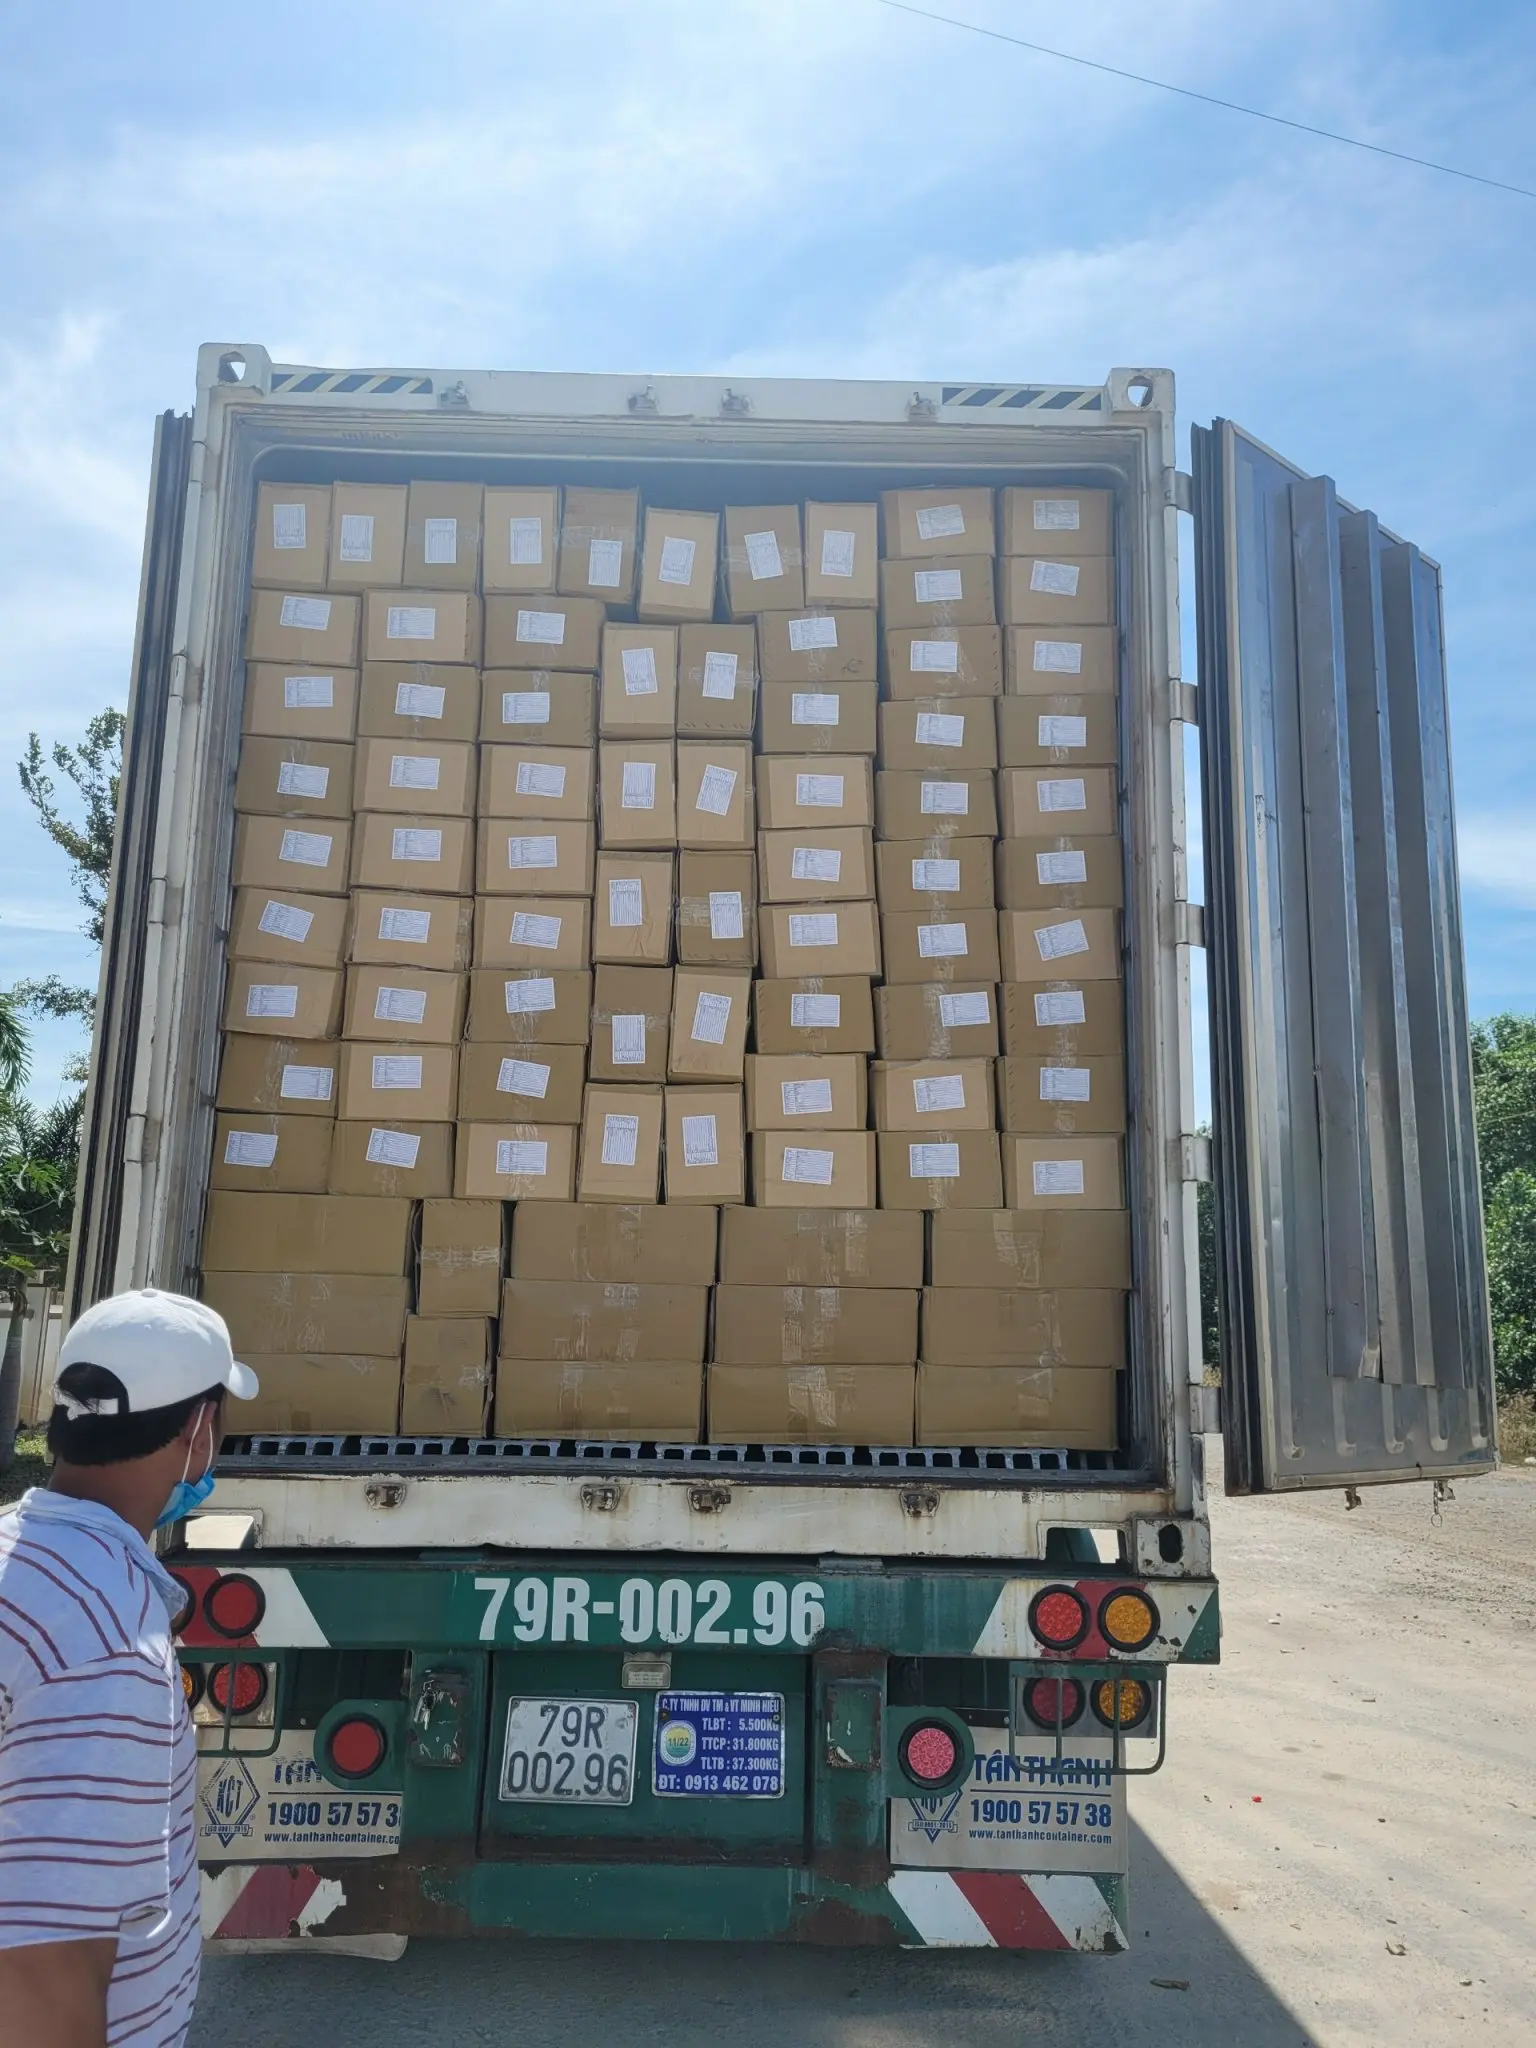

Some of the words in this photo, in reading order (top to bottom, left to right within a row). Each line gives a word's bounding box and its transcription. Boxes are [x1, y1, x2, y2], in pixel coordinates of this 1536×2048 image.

[474, 1577, 825, 1647] 79R-002.96
[680, 1698, 699, 1712] TNHH
[712, 1699, 723, 1712] TM
[725, 1703, 729, 1713] &
[731, 1699, 739, 1713] VT
[740, 1699, 760, 1713] MINH
[538, 1704, 605, 1749] 79R
[733, 1737, 779, 1751] 31.800KG
[507, 1751, 629, 1797] 002.96
[732, 1757, 779, 1771] 37.300KG
[974, 1749, 1020, 1785] TÂN
[658, 1774, 680, 1790] ĐT:
[684, 1775, 719, 1790] 0913
[722, 1776, 748, 1791] 462
[752, 1776, 779, 1791] 078
[268, 1802, 321, 1826] 1900
[327, 1802, 352, 1826] 57
[357, 1802, 382, 1827] 57
[386, 1803, 401, 1828] 3
[970, 1799, 1021, 1824] 1900
[1028, 1801, 1052, 1825] 57
[1056, 1802, 1080, 1826] 57
[1084, 1803, 1112, 1827] 38
[969, 1828, 1112, 1845] www.tanthanhcontainer.com
